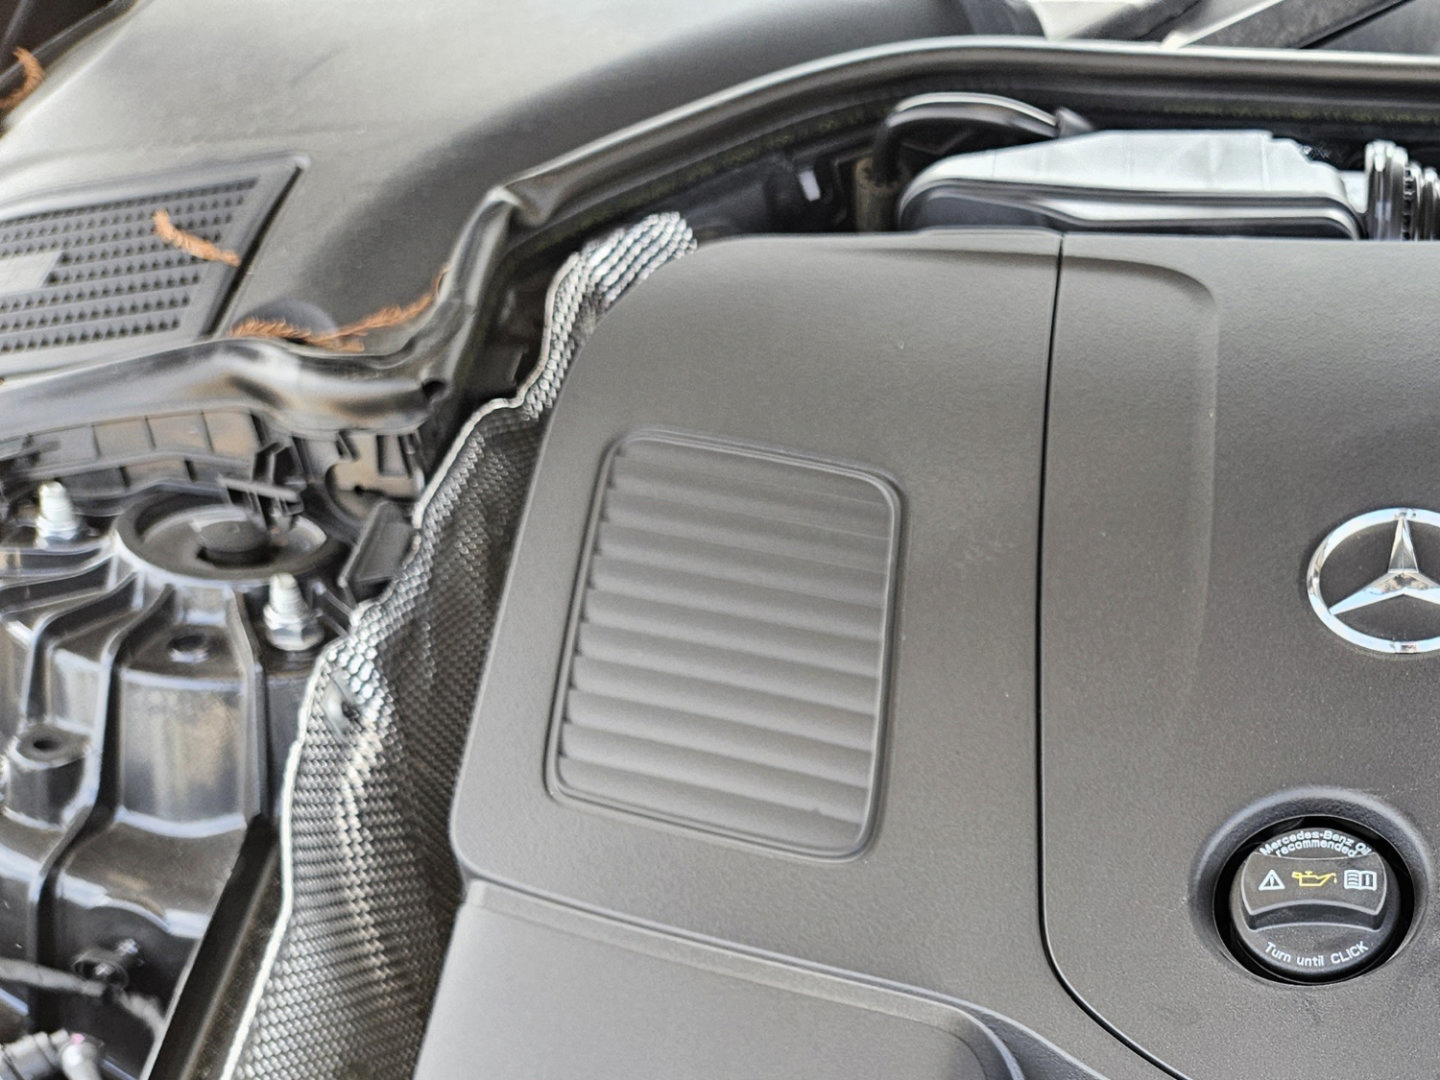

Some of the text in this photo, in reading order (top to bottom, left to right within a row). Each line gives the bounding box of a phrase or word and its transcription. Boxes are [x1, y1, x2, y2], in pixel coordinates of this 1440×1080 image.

[1259, 830, 1372, 857] Mercedes-Benz Oil
[1275, 837, 1357, 858] recommended
[1264, 941, 1369, 967] Turn until CLICK
